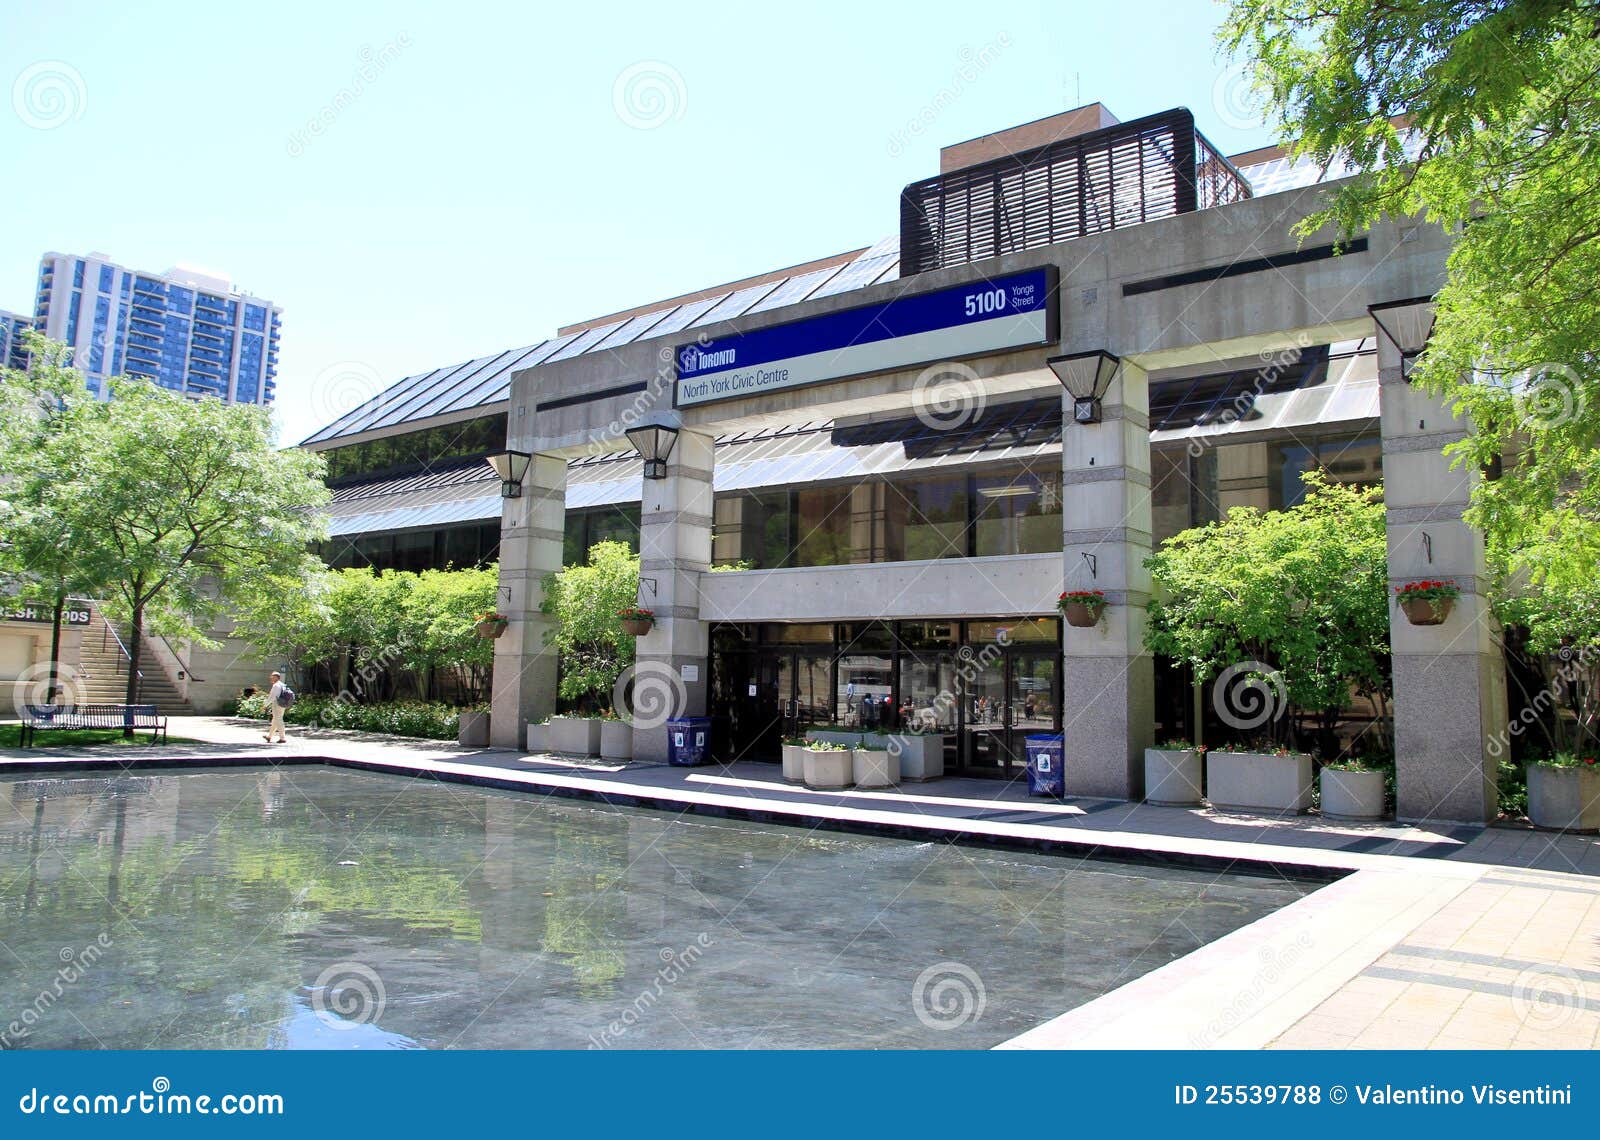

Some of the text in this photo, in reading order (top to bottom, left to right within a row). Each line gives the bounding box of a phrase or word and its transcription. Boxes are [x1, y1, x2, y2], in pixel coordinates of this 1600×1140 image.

[1012, 284, 1034, 296] Yonge
[965, 288, 1006, 316] 5100
[1012, 296, 1034, 308] Street
[698, 348, 736, 370] TORONTO
[683, 369, 789, 399] North York Civic Centre
